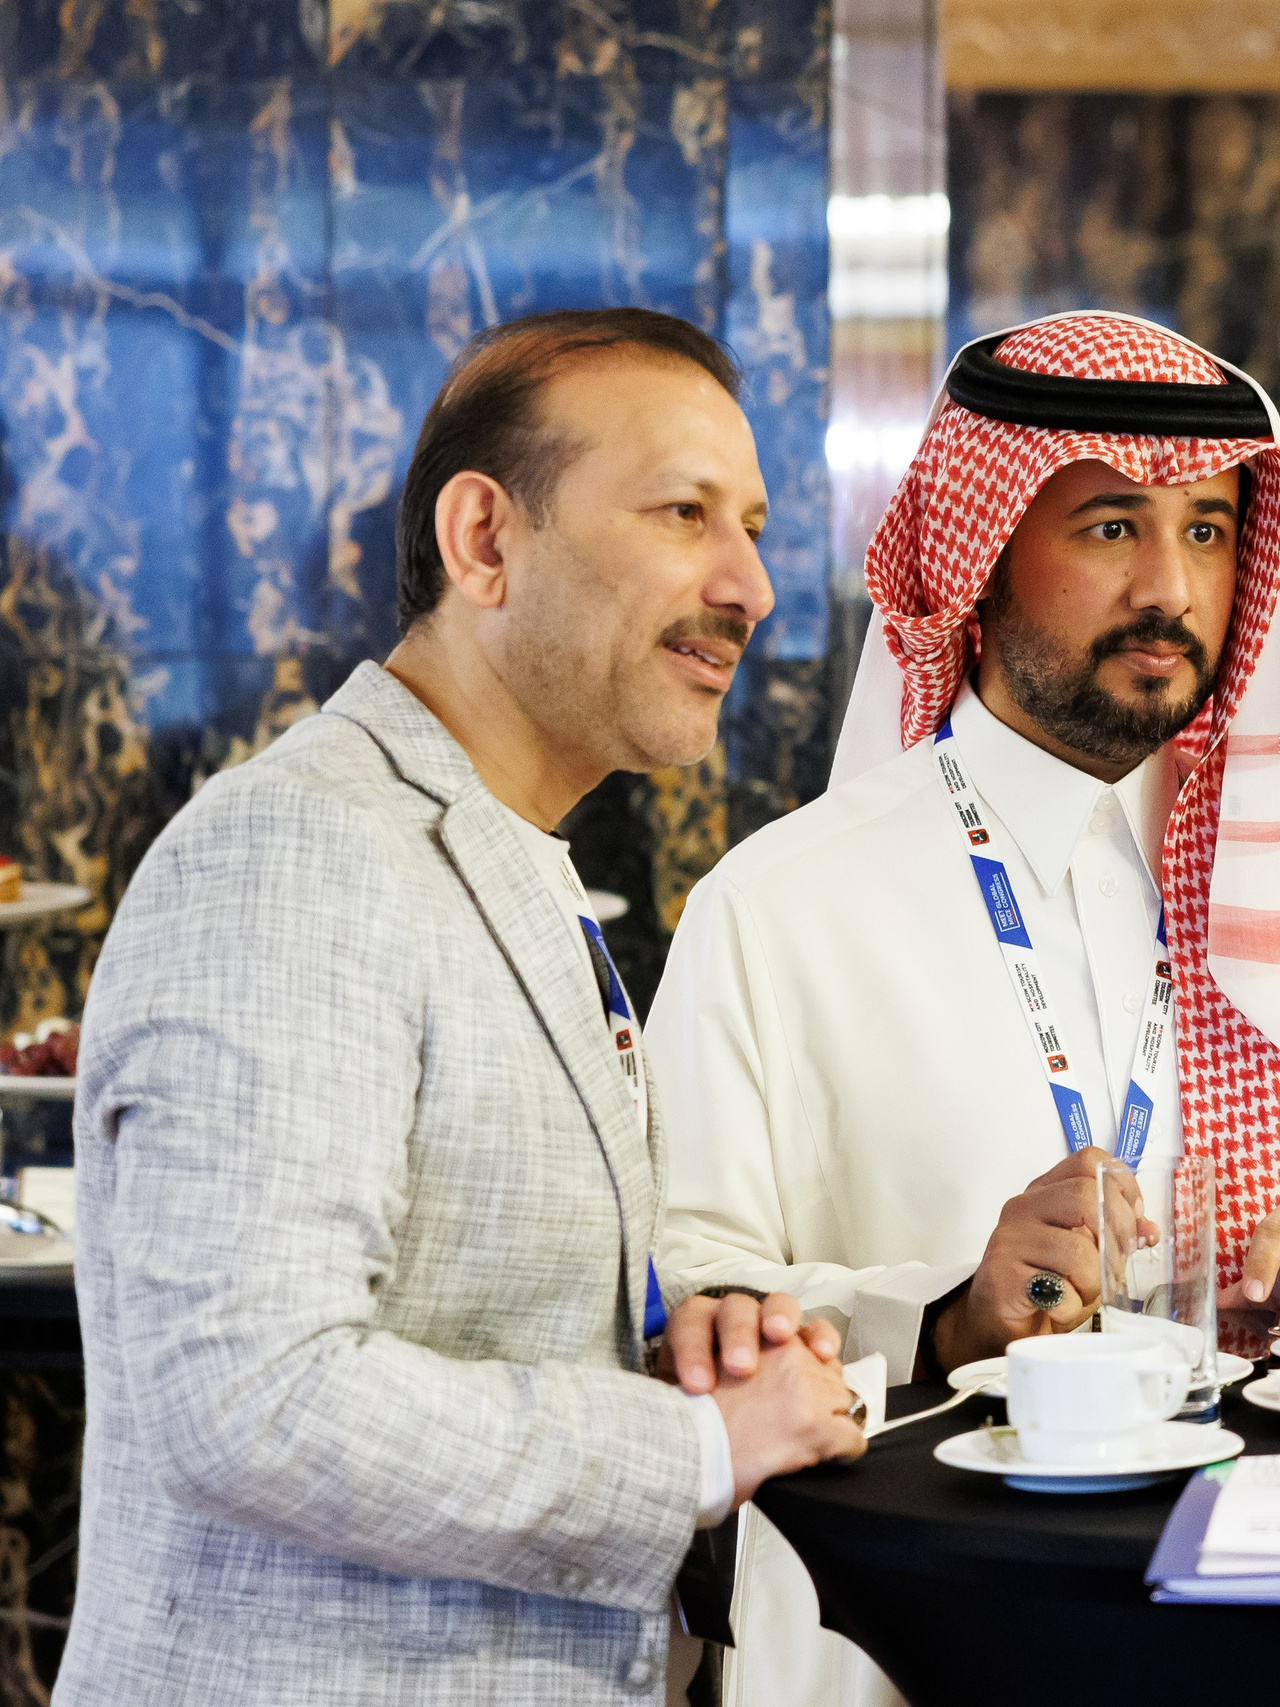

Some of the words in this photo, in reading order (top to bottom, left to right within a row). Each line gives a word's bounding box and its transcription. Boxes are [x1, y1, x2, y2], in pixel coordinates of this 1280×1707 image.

[990, 883, 1002, 909] GLOBAL
[992, 873, 1008, 908] CONGRESS
[998, 910, 1008, 927] MEET
[1005, 909, 1014, 925] MICE
[1015, 963, 1025, 987] TOURISM
[1021, 963, 1036, 997] HOSPITALITY
[1031, 974, 1047, 1009] DEVELOPMENT
[1142, 1021, 1152, 1057] DEVELOPMENT
[1146, 1036, 1155, 1071] HOSPITALITY
[1069, 1112, 1080, 1140] GLOBAL
[1071, 1103, 1086, 1140] CONGRESS
[1137, 1111, 1145, 1130] MEET
[1131, 1130, 1141, 1156] GLOBAL
